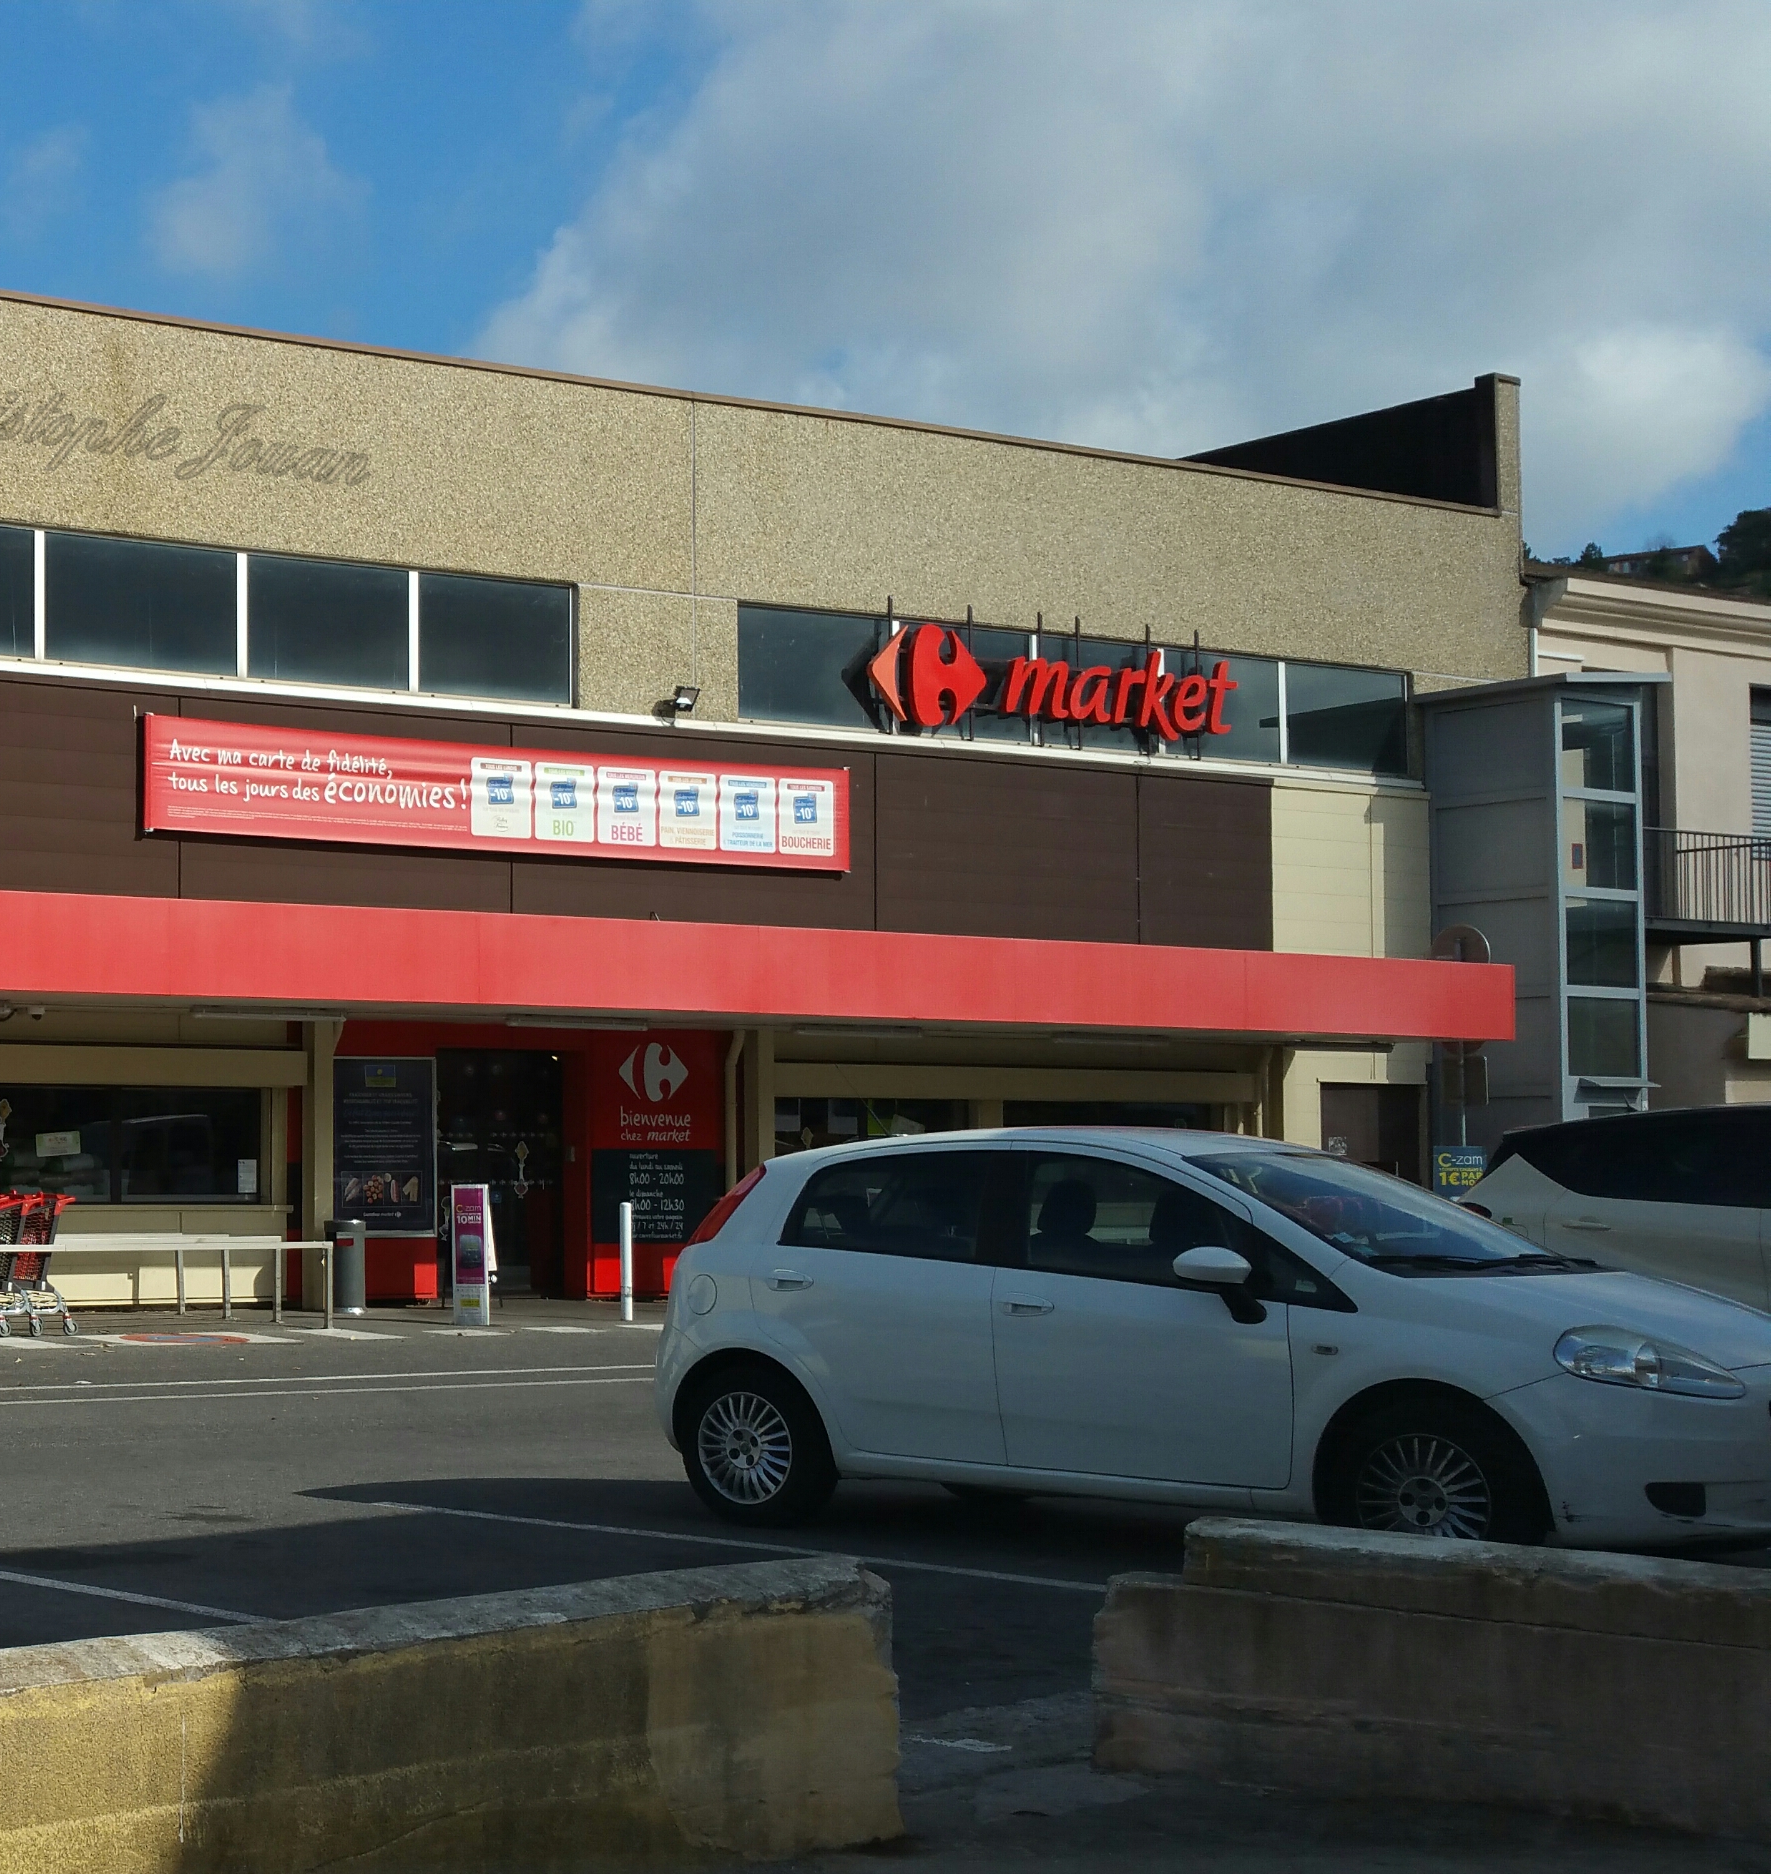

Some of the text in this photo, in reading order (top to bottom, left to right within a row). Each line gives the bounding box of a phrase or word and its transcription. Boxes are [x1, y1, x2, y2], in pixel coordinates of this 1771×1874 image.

[1000, 648, 1238, 741] market
[169, 738, 393, 779] Avec ma carte de fidélité,
[167, 771, 208, 793] tous
[215, 774, 238, 795] les
[243, 778, 289, 802] jours
[292, 779, 320, 802] des
[553, 820, 574, 836] BIO
[611, 822, 643, 842] BÉBÉ
[782, 835, 831, 850] BOUCHERIE
[620, 1105, 691, 1127] bienvenue
[620, 1129, 691, 1143] chez market
[638, 1162, 654, 1170] lundi
[1437, 1152, 1483, 1168] C-zam
[629, 1172, 650, 1185] 8h00
[659, 1172, 684, 1185] 20h00
[1439, 1171, 1460, 1186] 1€
[1461, 1179, 1476, 1187] MO
[636, 1188, 664, 1198] dimanche
[660, 1198, 685, 1211] 12h30
[456, 1215, 468, 1224] 10
